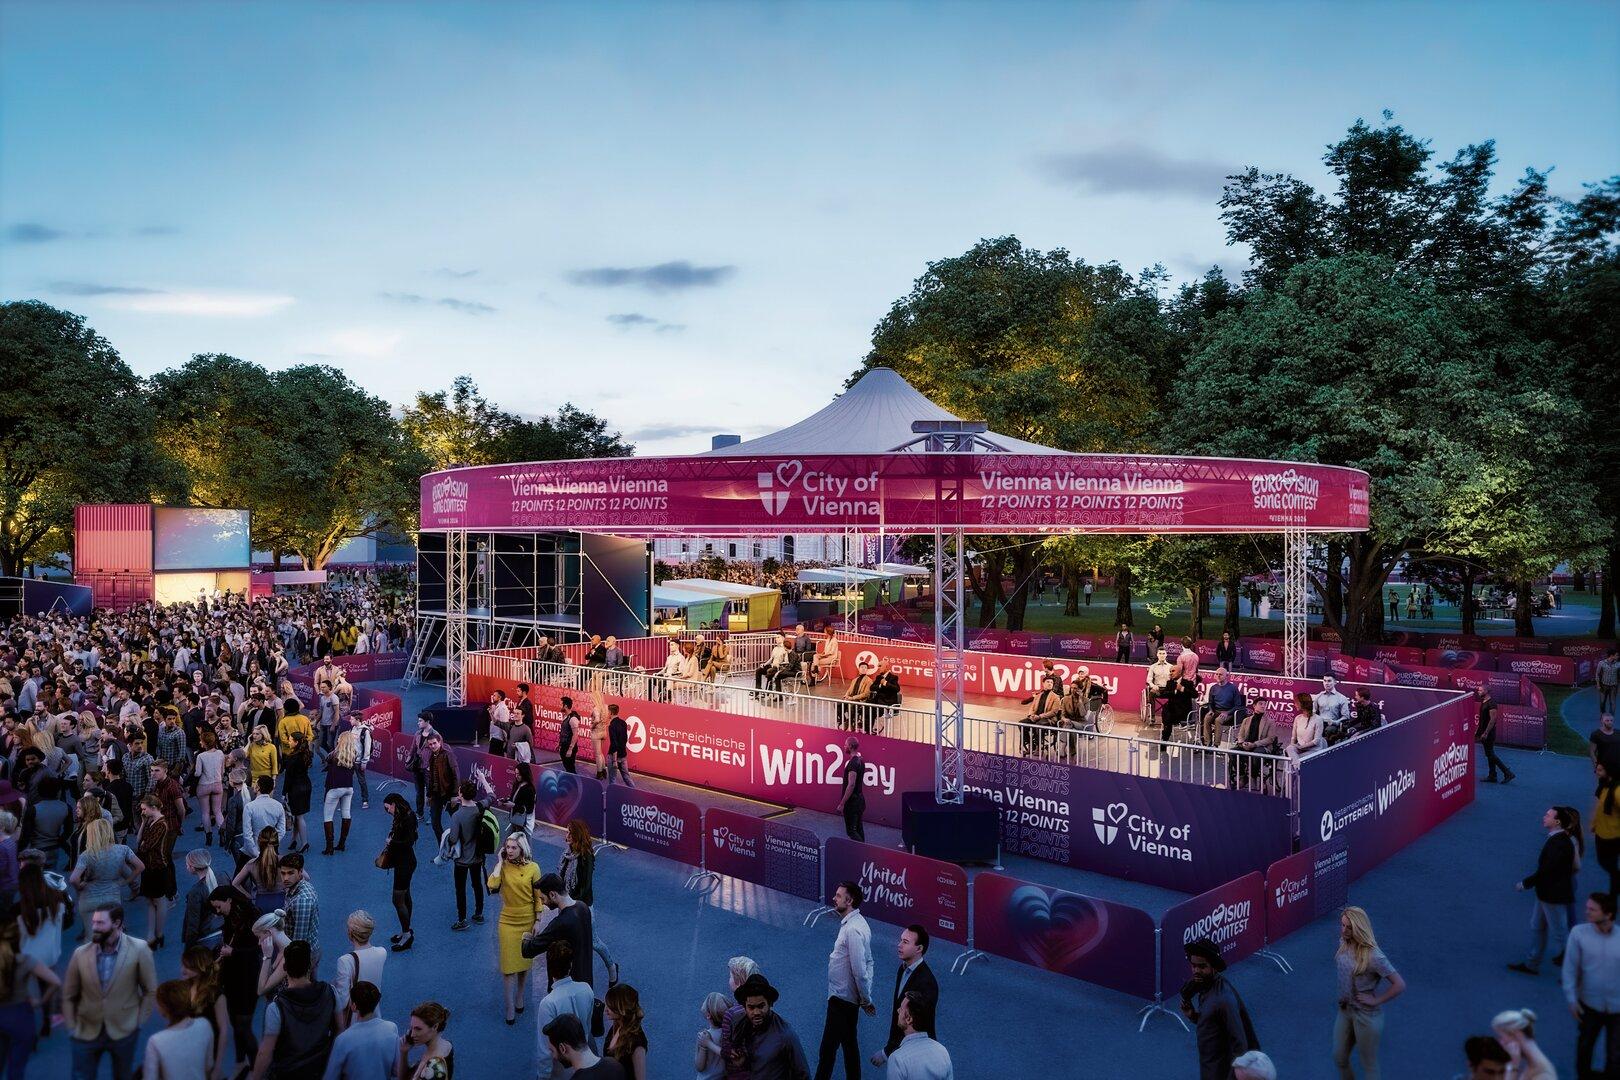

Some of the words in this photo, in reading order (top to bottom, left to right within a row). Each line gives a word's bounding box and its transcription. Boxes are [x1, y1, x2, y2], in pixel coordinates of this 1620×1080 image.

[512, 478, 555, 496] Vienna
[556, 477, 607, 495] Vienna
[609, 475, 668, 493] Vienna
[802, 472, 849, 497] City
[854, 471, 879, 492] of
[980, 471, 1051, 491] Vienna
[1054, 471, 1121, 492] Vienna
[1123, 473, 1184, 493] Vienna
[512, 501, 520, 512] 12
[521, 500, 554, 512] POINTS
[556, 499, 565, 511] 12
[567, 498, 607, 511] POINTS
[609, 498, 620, 510] 12
[622, 497, 668, 510] POINTS
[803, 495, 880, 516] Vienna
[980, 495, 995, 508] 12
[998, 494, 1051, 508] POINTS
[1054, 495, 1068, 508] 12
[1071, 496, 1120, 509] POINTS
[1124, 496, 1137, 509] 12
[1139, 497, 1184, 510] POINTS
[622, 512, 668, 525] POINTS
[535, 704, 563, 721] Vienna
[1522, 714, 1543, 722] Vienna
[650, 724, 745, 750] österreichische
[650, 737, 745, 768] LOTTERIEN
[1006, 758, 1019, 773] 12
[1021, 760, 1070, 780] POINTS
[1006, 773, 1019, 786] 12
[1021, 774, 1070, 795] POINTS
[1006, 787, 1070, 816] Vienna
[1006, 810, 1018, 823] 12
[1021, 812, 1070, 833] POINTS
[1334, 802, 1374, 831] LOTTERIEN
[1021, 827, 1070, 848] POINTS
[1128, 814, 1165, 841] City
[1169, 824, 1191, 841] of
[728, 833, 745, 846] City
[746, 838, 756, 847] of
[728, 842, 756, 858] Vienna
[765, 834, 790, 848] Vienna
[790, 840, 818, 855] Vienna
[1128, 833, 1192, 861] Vienna
[771, 845, 791, 855] POINTS
[797, 851, 818, 862] POINTS
[1021, 841, 1070, 862] POINTS
[862, 861, 907, 890] United
[1288, 881, 1300, 892] City
[1301, 874, 1308, 886] of
[874, 884, 914, 908] Music
[1288, 888, 1308, 903] Vienna
